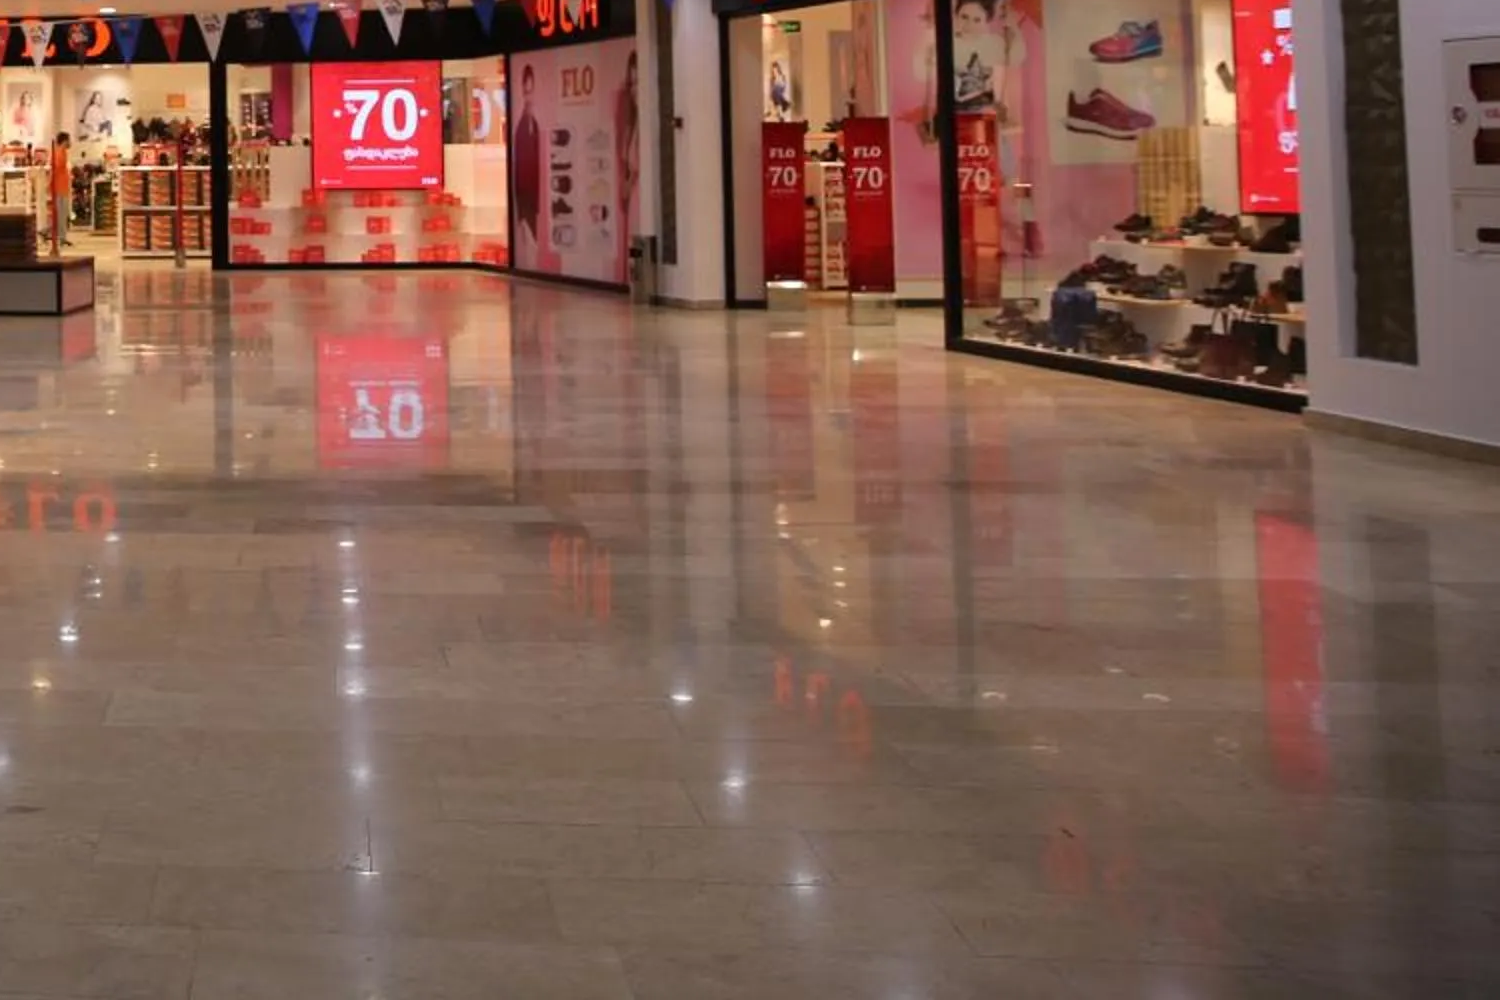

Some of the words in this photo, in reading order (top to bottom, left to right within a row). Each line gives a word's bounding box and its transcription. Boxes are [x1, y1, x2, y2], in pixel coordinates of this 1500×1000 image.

[561, 65, 594, 98] FLO
[769, 147, 796, 159] FLO
[853, 146, 882, 158] FLO
[769, 166, 797, 187] 70
[852, 167, 883, 189] 70
[958, 167, 991, 192] 70
